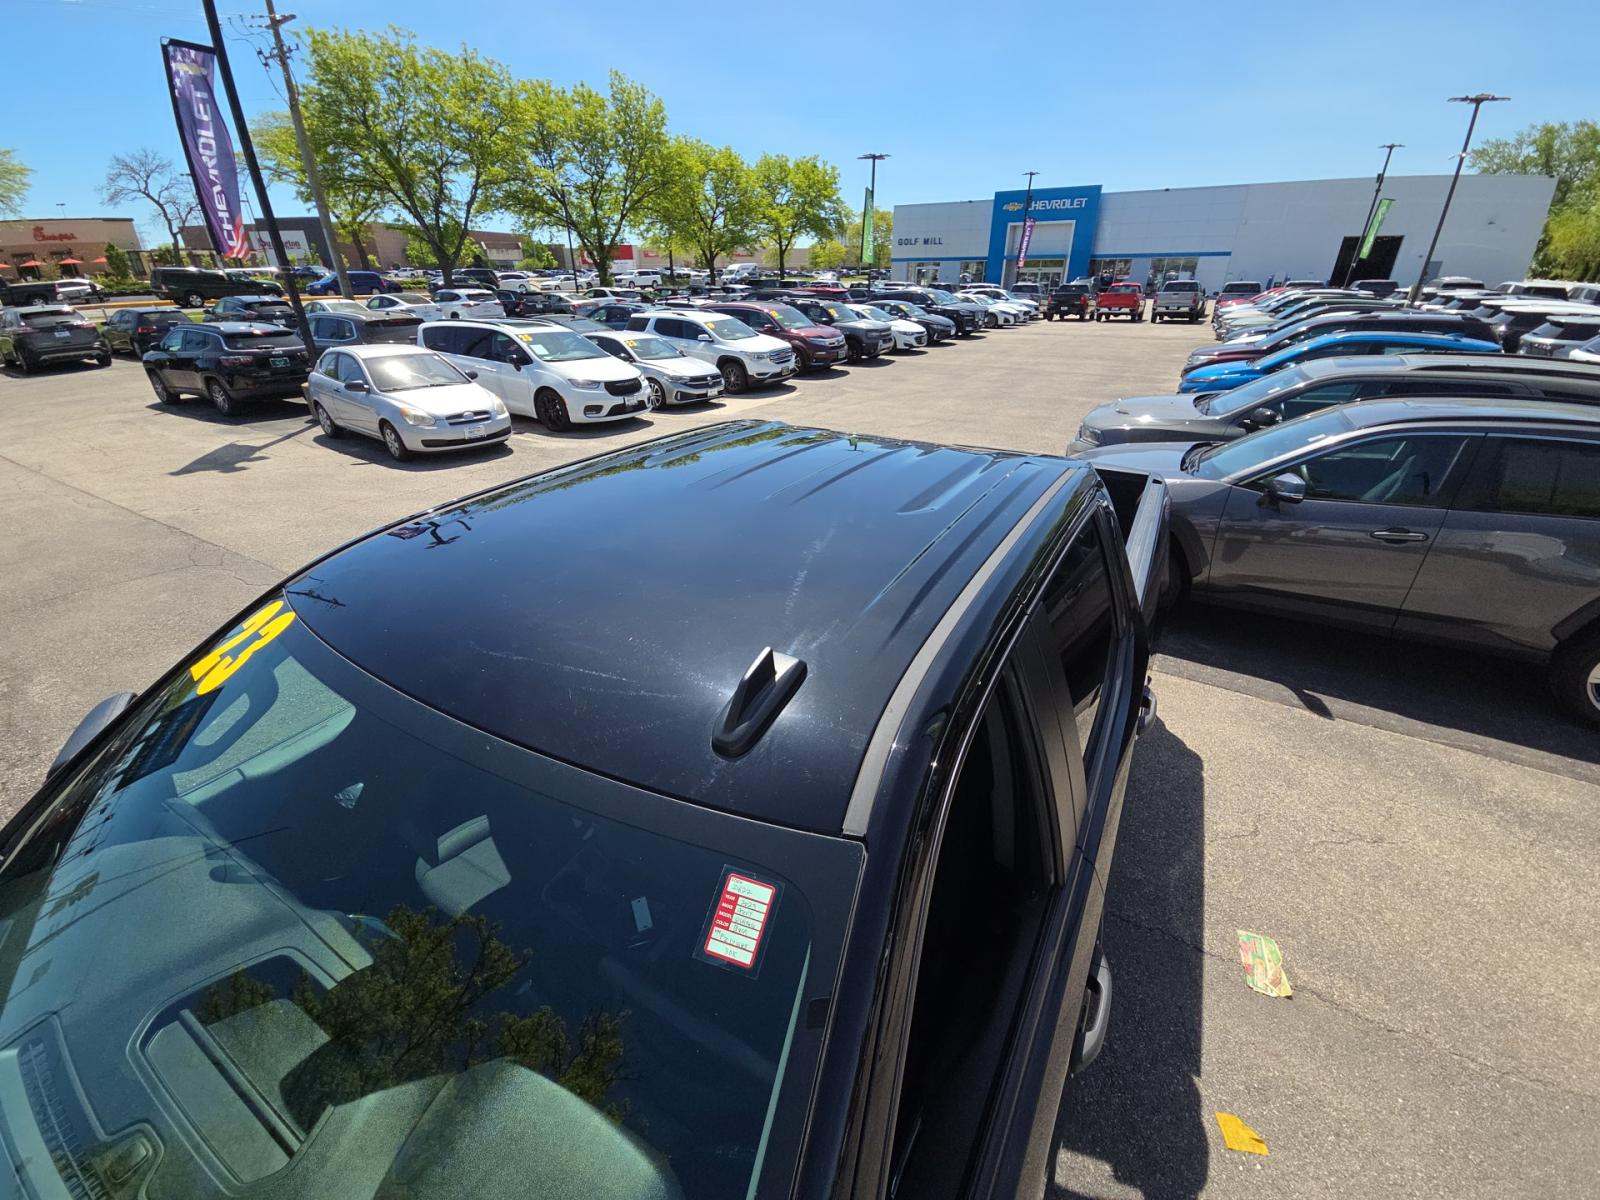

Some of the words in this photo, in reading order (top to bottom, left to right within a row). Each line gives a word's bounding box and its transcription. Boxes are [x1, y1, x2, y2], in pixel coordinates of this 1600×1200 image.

[191, 85, 238, 247] CHEVROLET
[897, 237, 920, 246] GOLF
[923, 237, 943, 245] MILL
[190, 600, 296, 696] 23
[715, 919, 730, 927] COLOR
